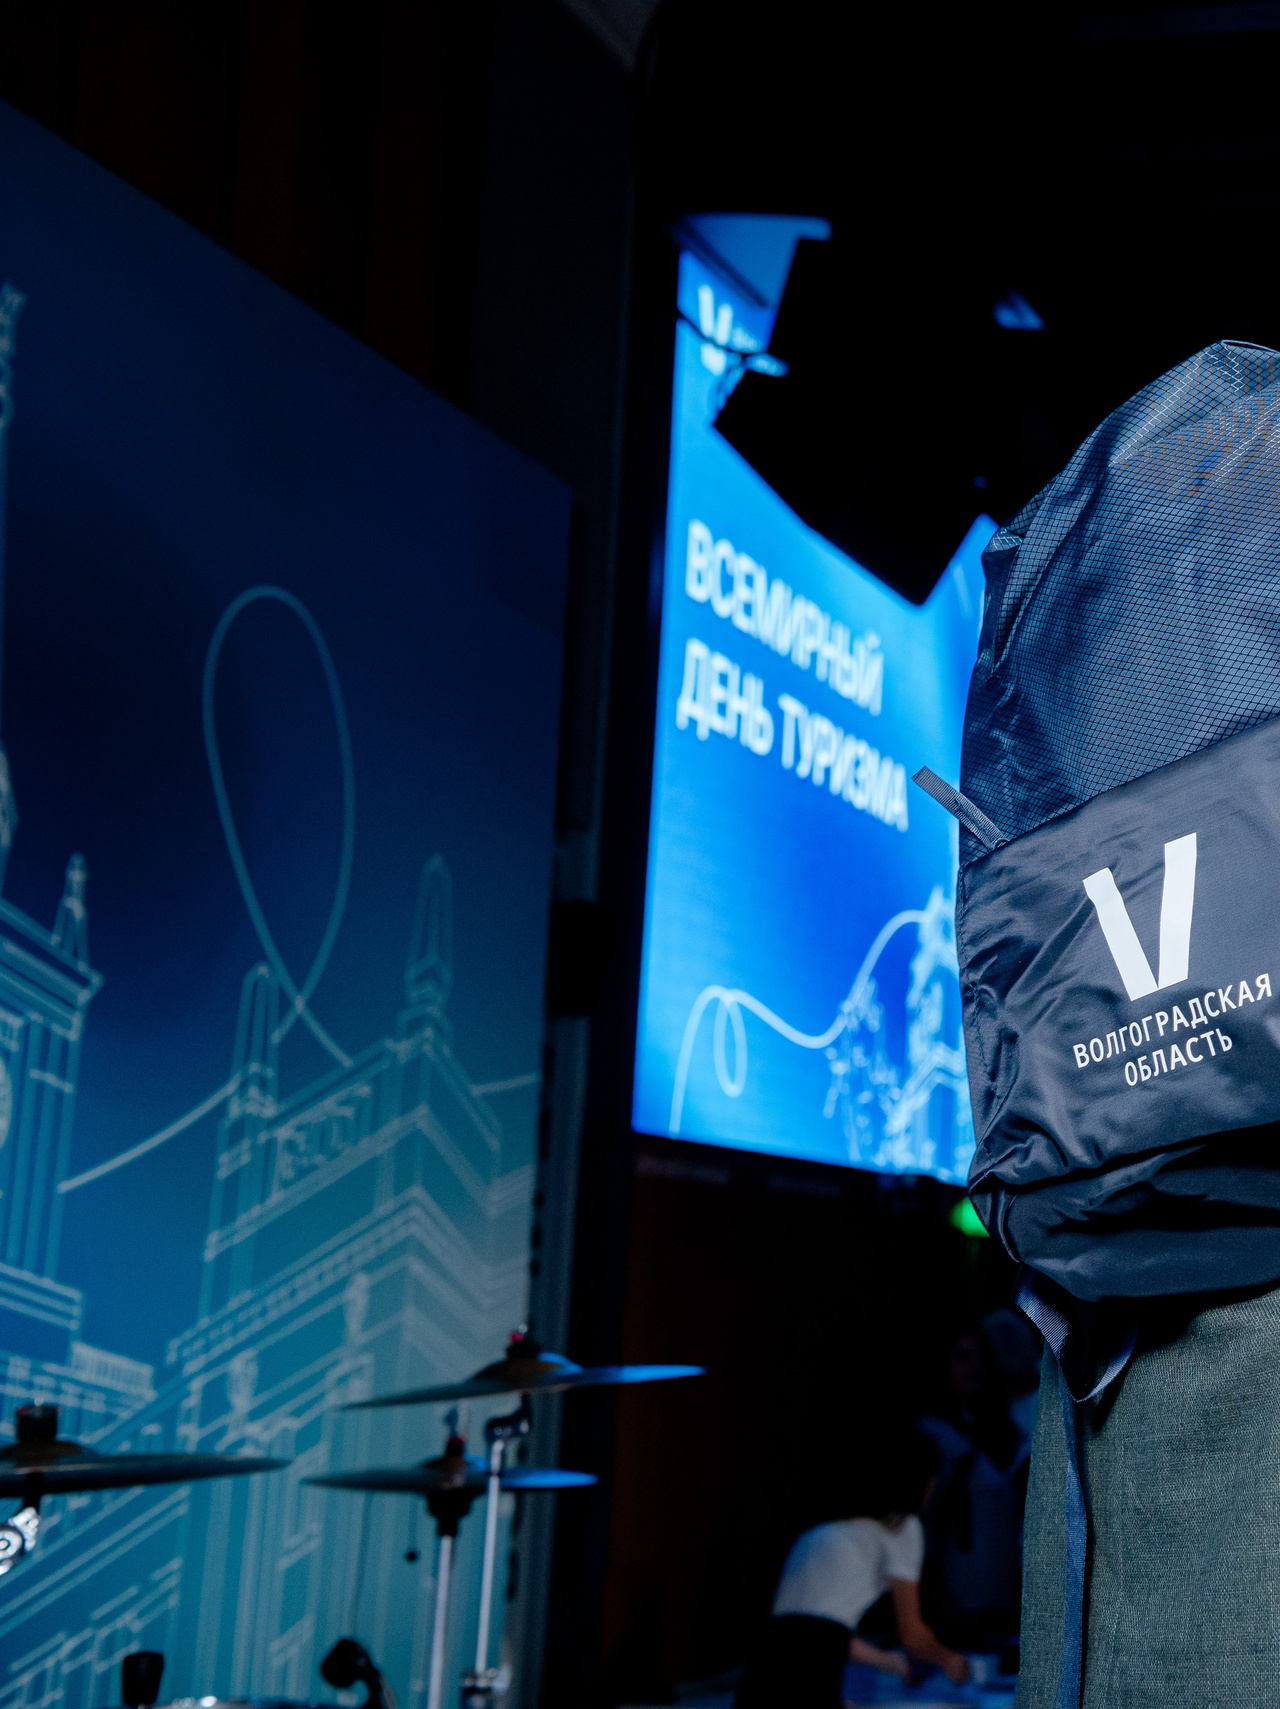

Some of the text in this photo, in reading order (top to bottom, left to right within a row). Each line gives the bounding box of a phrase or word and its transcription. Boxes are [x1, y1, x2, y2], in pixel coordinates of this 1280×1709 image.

[685, 518, 884, 717] ВСЕМИРНЫЙ
[676, 637, 909, 833] ДЕНЬ ТУРИЗМА
[1083, 832, 1197, 1001] V
[1073, 973, 1272, 1068] ВОЛГОГРАДСКАЯ
[1124, 1028, 1233, 1086] ОБЛАСТЬ
